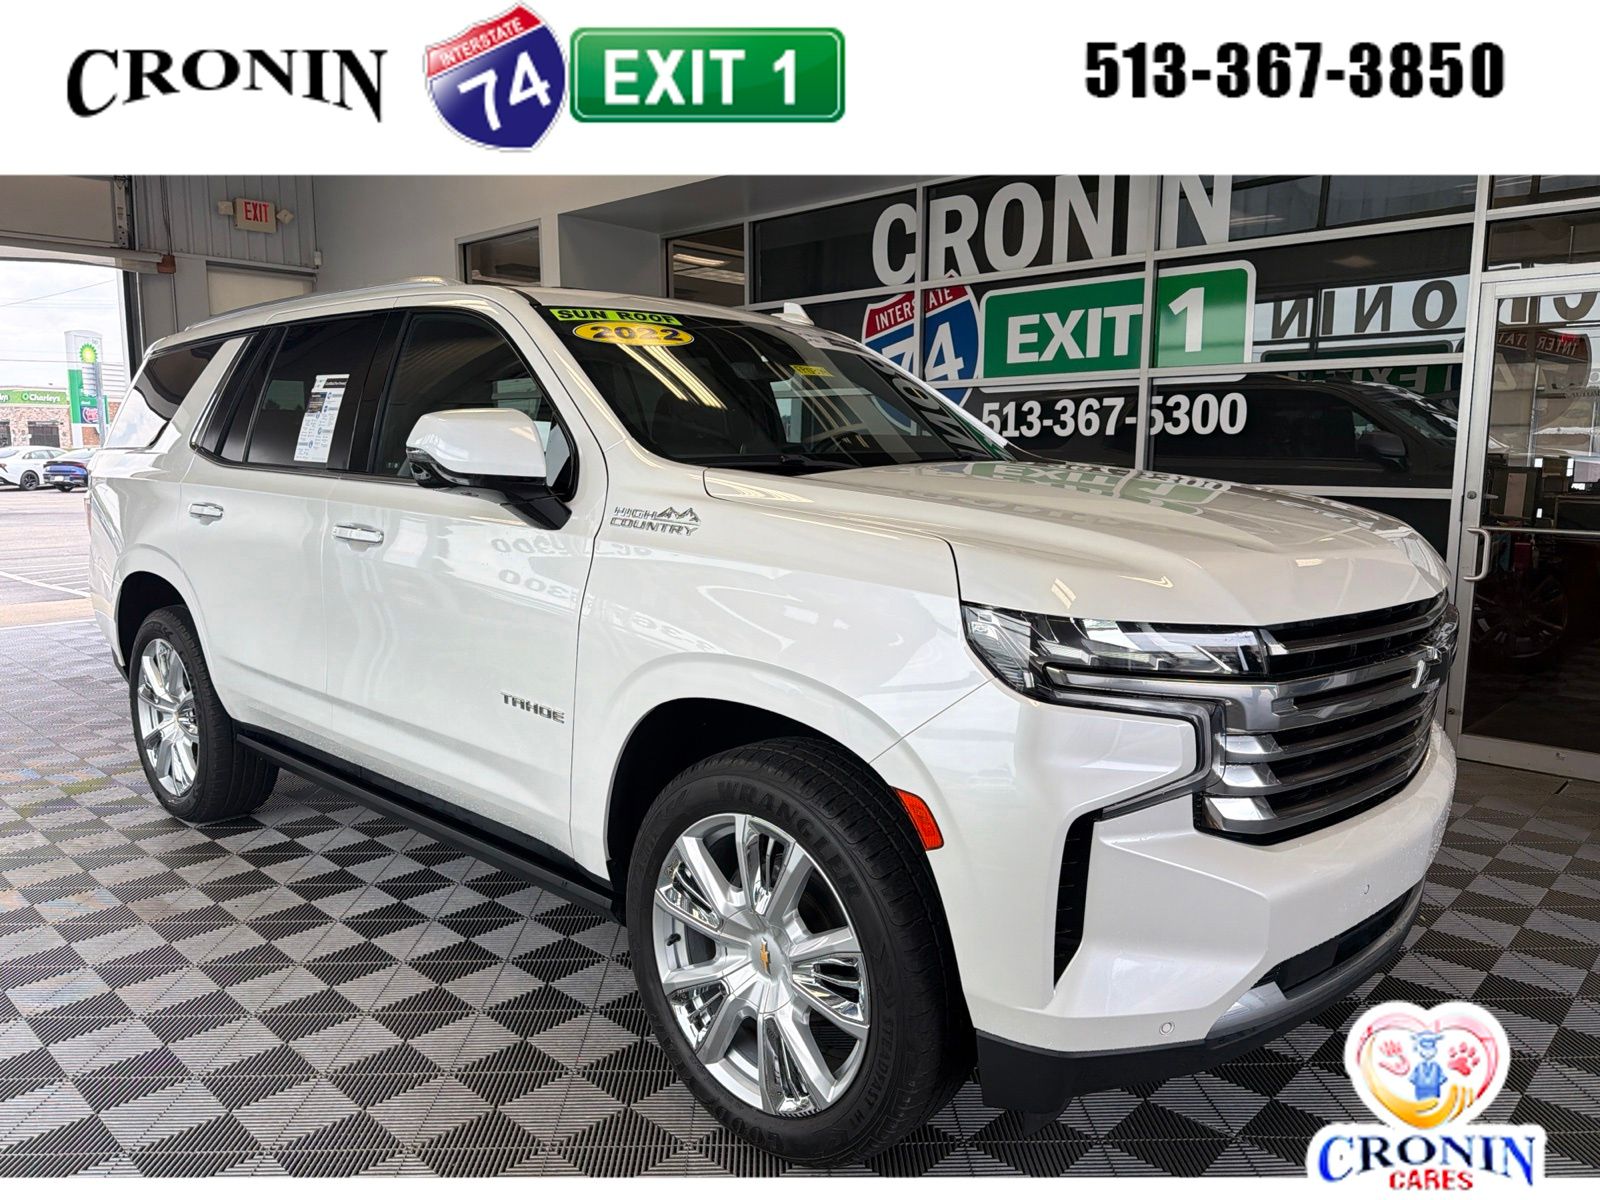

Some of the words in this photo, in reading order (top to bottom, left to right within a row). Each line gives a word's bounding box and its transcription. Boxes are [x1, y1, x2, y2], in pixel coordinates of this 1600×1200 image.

[243, 200, 269, 223] EXIT
[872, 174, 1233, 287] CRONIN
[557, 309, 607, 320] SUN
[617, 312, 675, 325] ROOF
[875, 288, 954, 331] INTERATE
[1006, 304, 1143, 364] EXIT
[1168, 287, 1205, 353] 1
[590, 325, 684, 342] 2022
[882, 321, 965, 381] 74
[981, 393, 1248, 438] 513-367-5300
[610, 517, 698, 536] COUNTRY
[614, 507, 657, 518] HIGH
[500, 691, 565, 724] TAHOE
